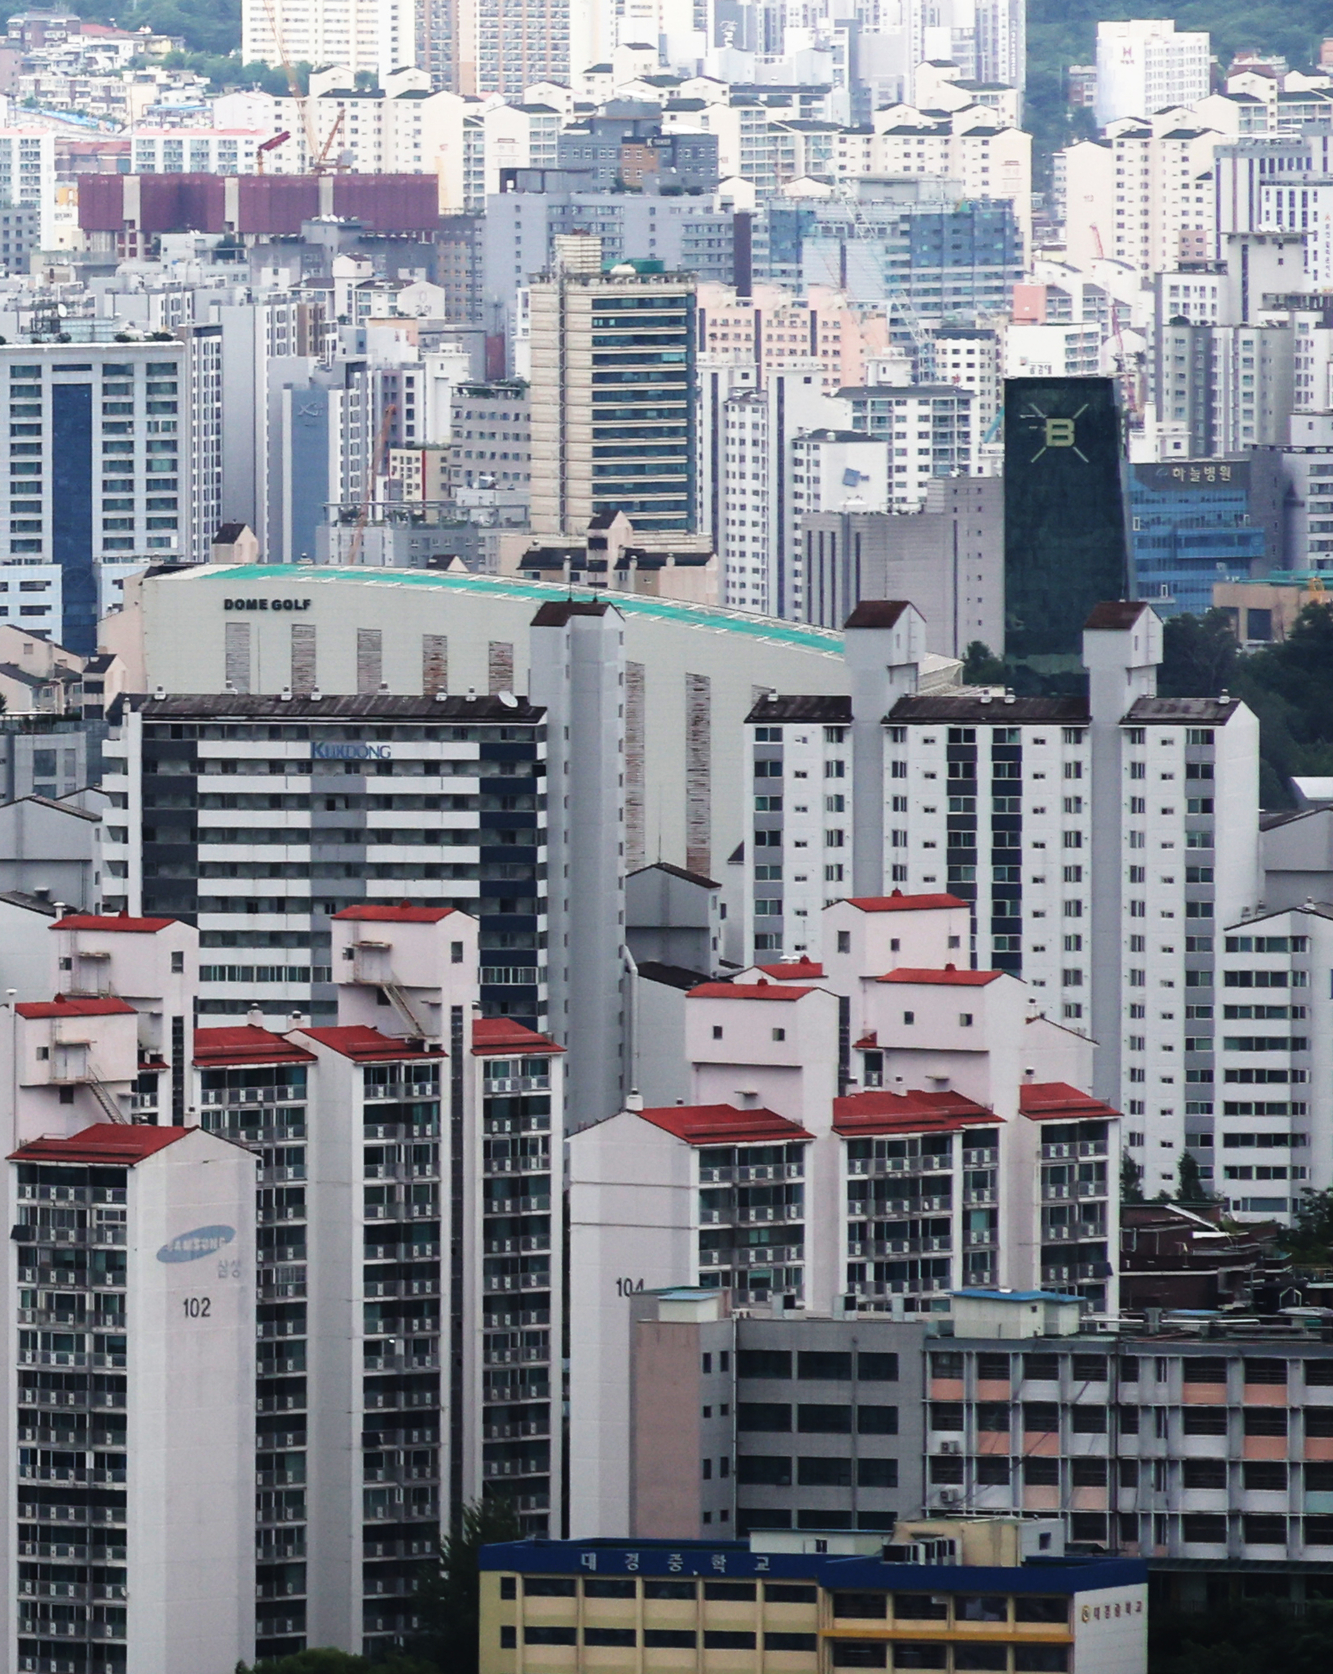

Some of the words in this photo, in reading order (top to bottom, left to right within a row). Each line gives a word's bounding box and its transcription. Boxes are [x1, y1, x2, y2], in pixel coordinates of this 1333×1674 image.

[1172, 465, 1232, 483] 하늘병원
[222, 597, 268, 611] DOME
[270, 597, 312, 611] GOLF
[182, 1297, 212, 1319] 102
[580, 1550, 773, 1575] 대경중학교
